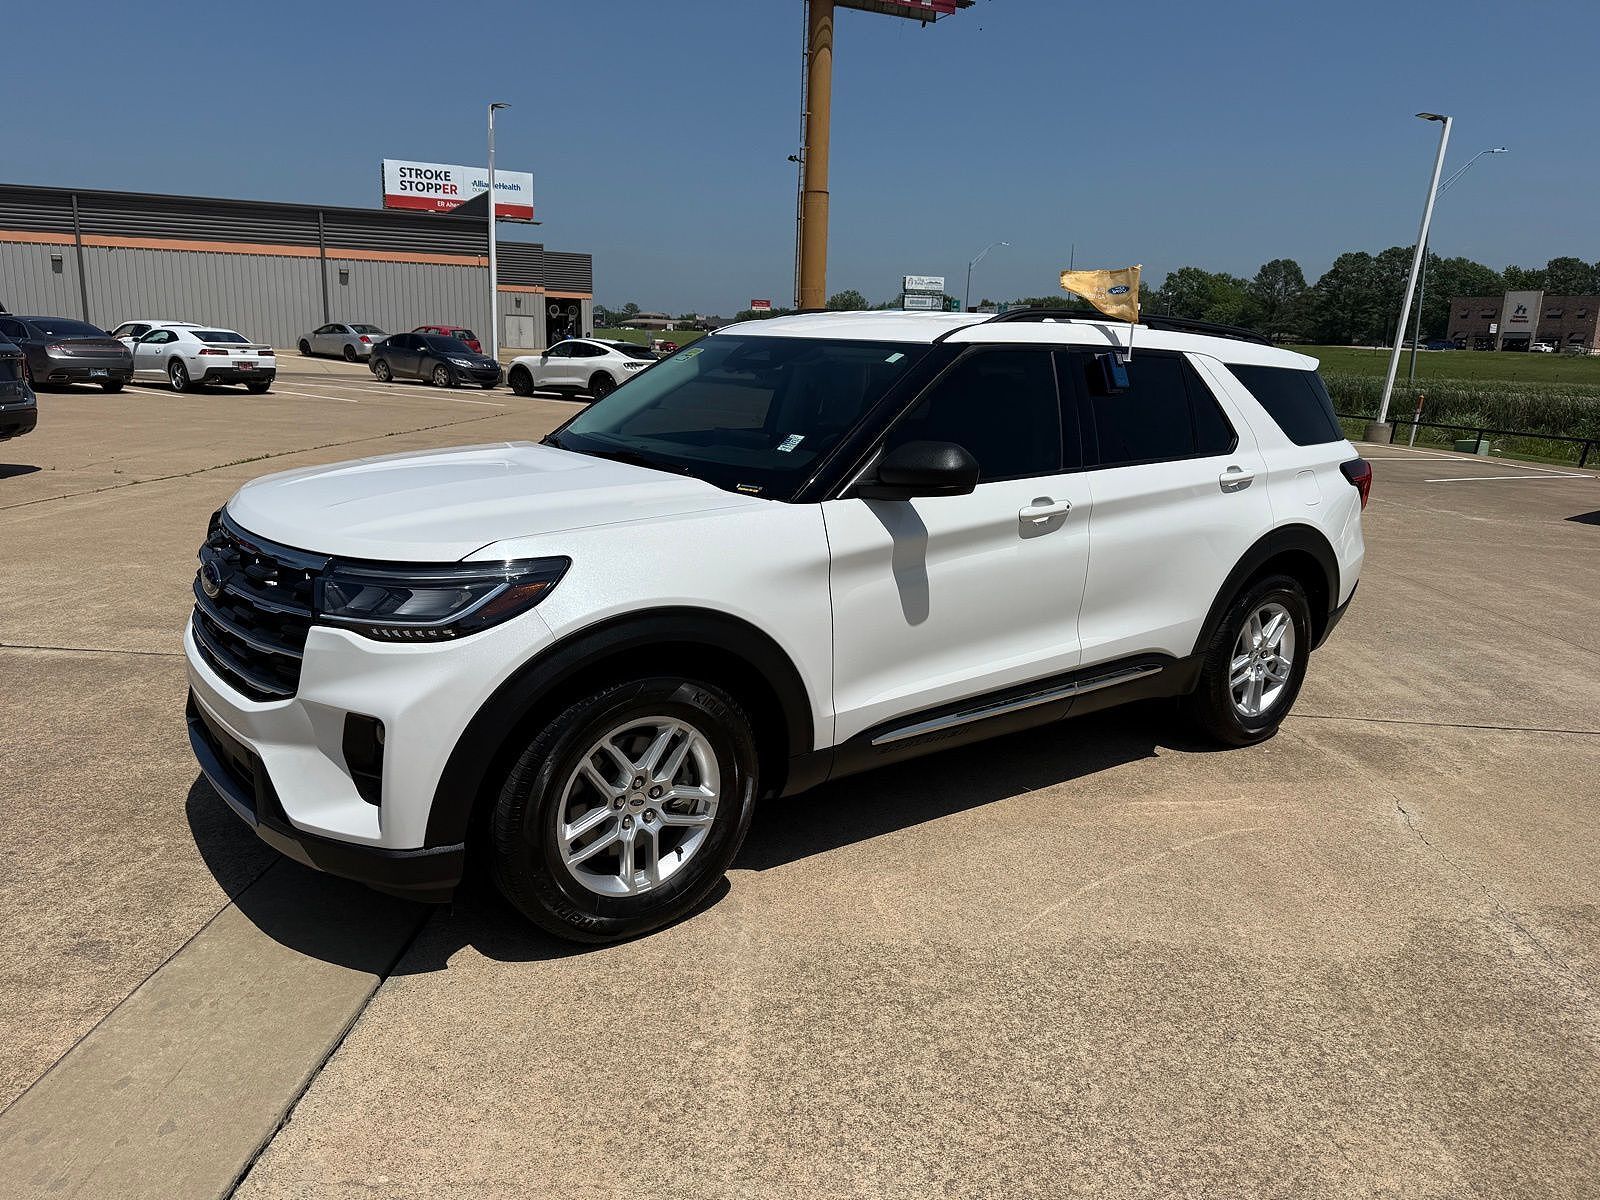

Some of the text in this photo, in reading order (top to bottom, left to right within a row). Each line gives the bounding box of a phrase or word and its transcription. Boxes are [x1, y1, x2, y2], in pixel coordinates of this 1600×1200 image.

[399, 167, 451, 181] STROKE
[400, 180, 458, 195] STOPPER
[472, 180, 521, 191] AlliaeHealth
